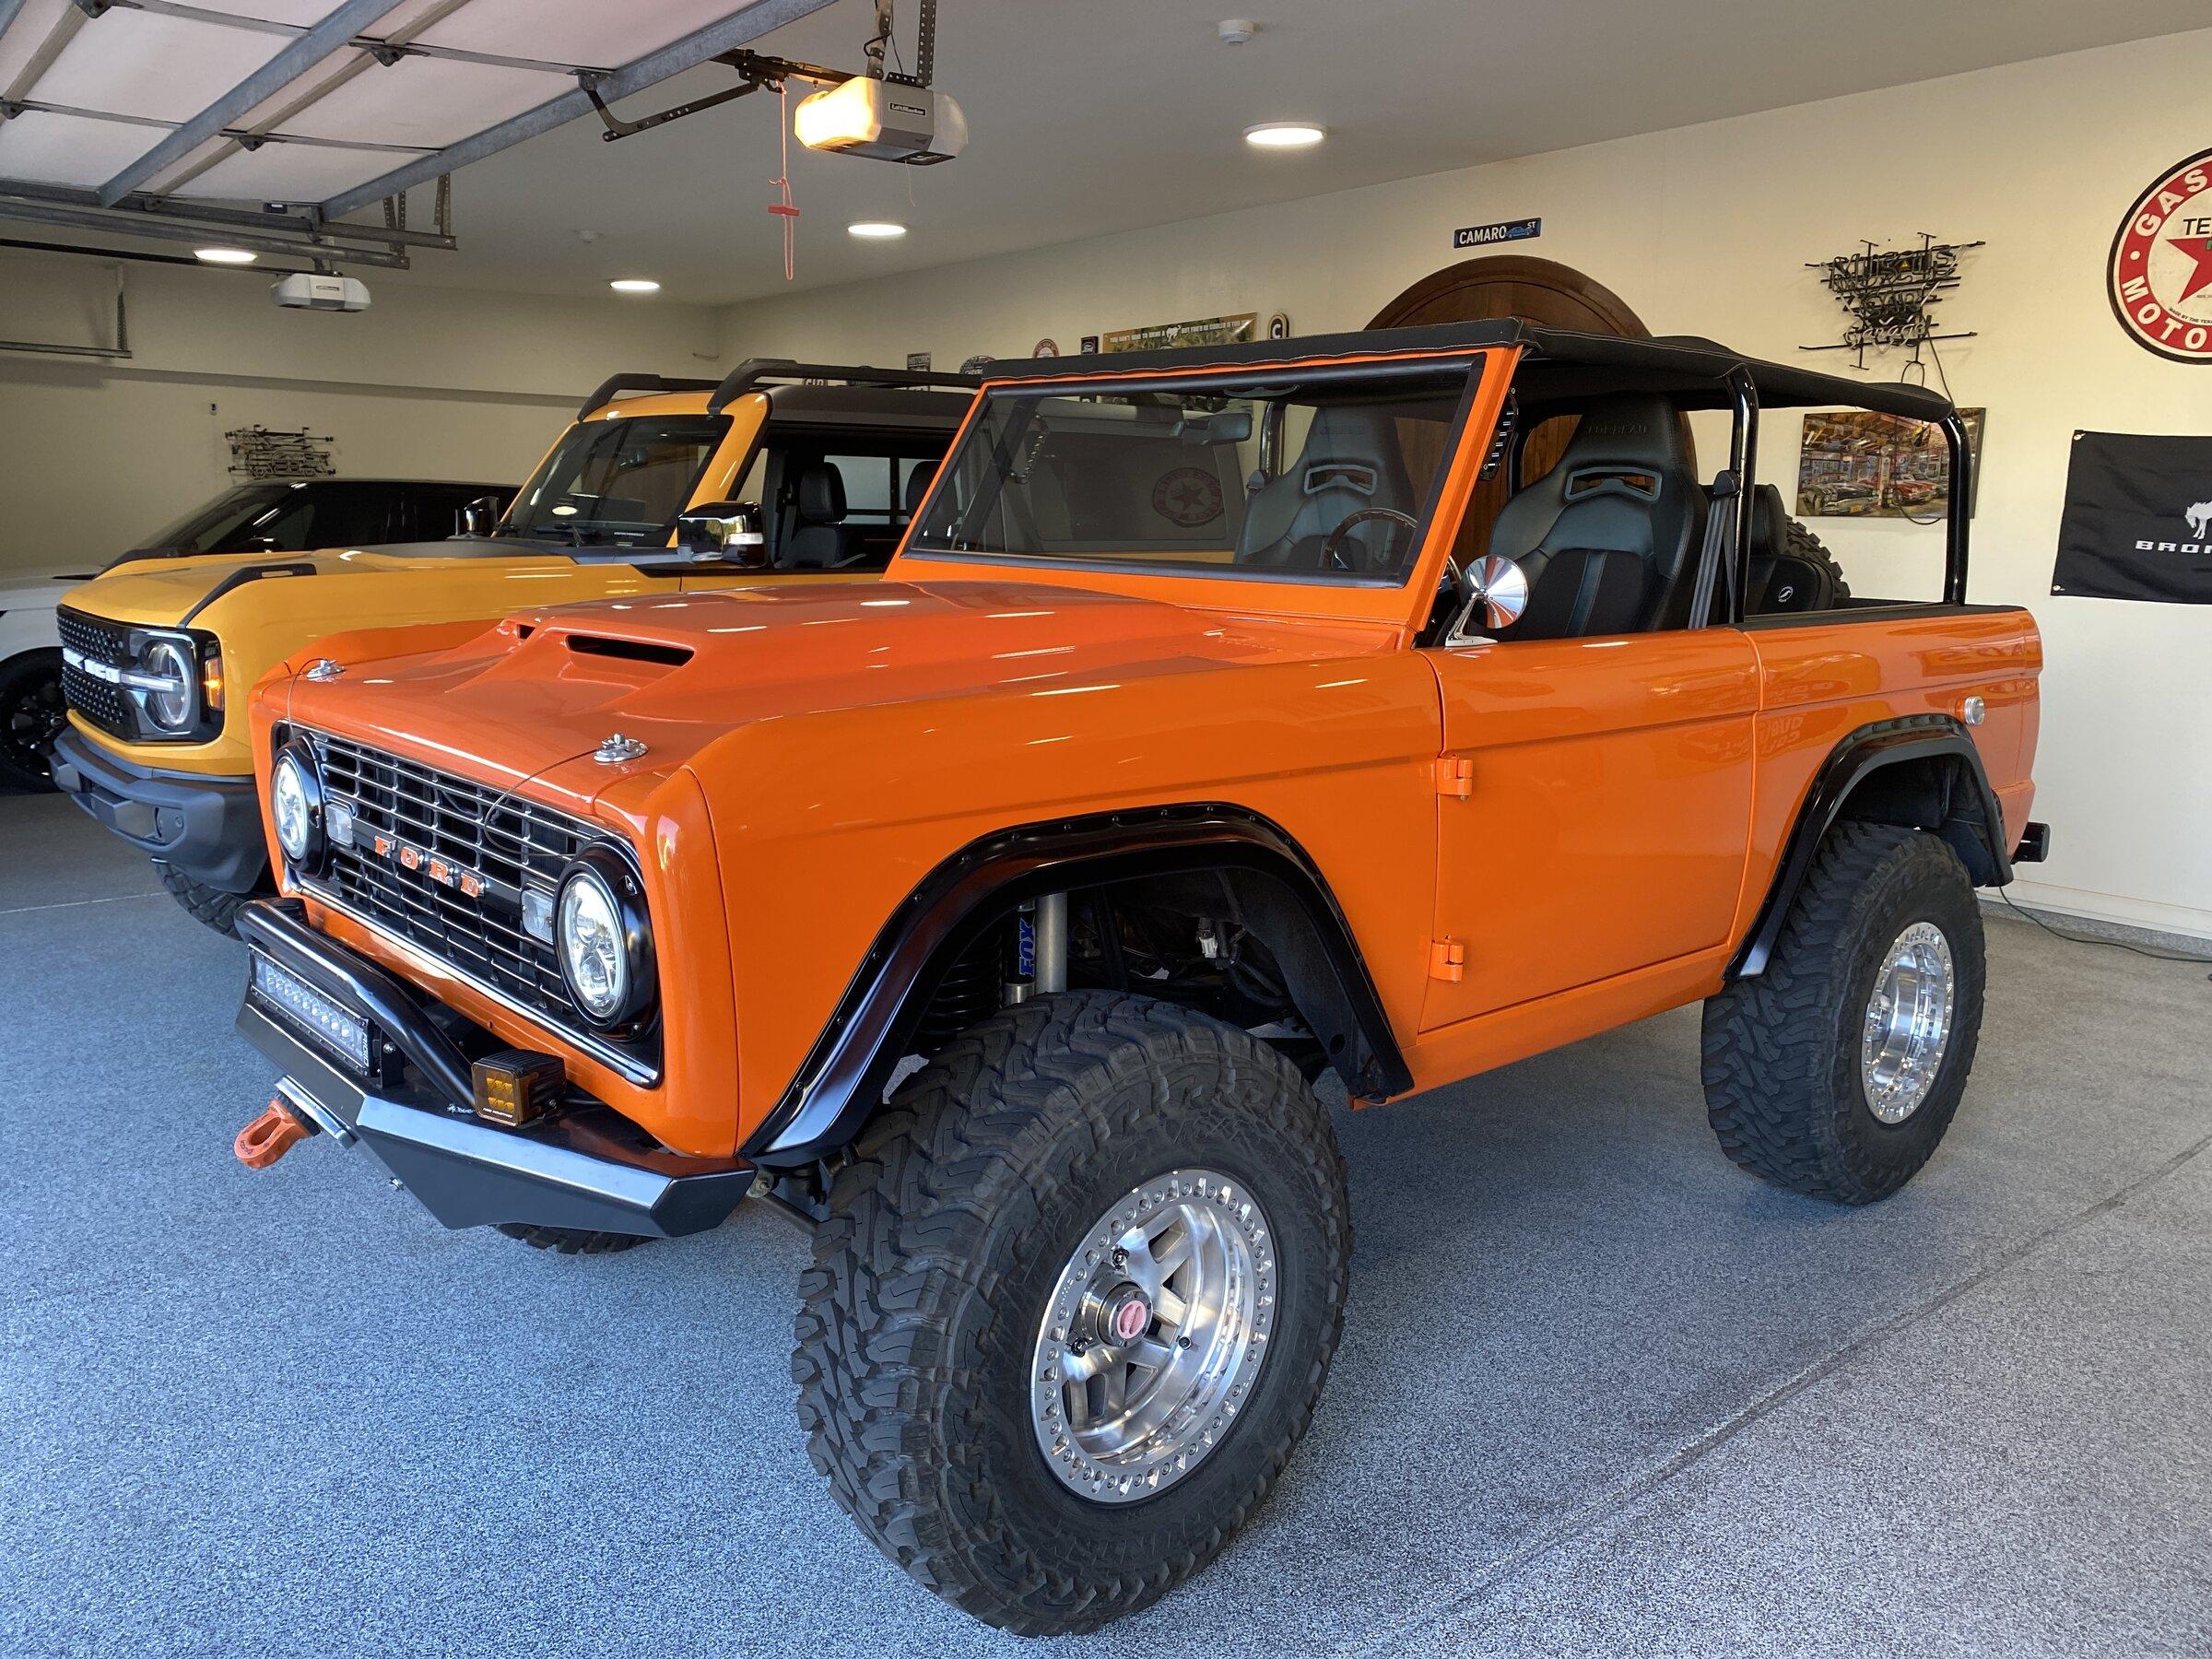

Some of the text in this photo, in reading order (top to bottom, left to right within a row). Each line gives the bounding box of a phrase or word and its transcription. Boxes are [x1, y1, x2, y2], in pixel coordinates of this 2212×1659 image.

[1459, 221, 1536, 244] CAMARO ST
[2183, 218, 2212, 235] TE
[374, 835, 486, 898] FORD
[1018, 917, 1035, 977] FOX
